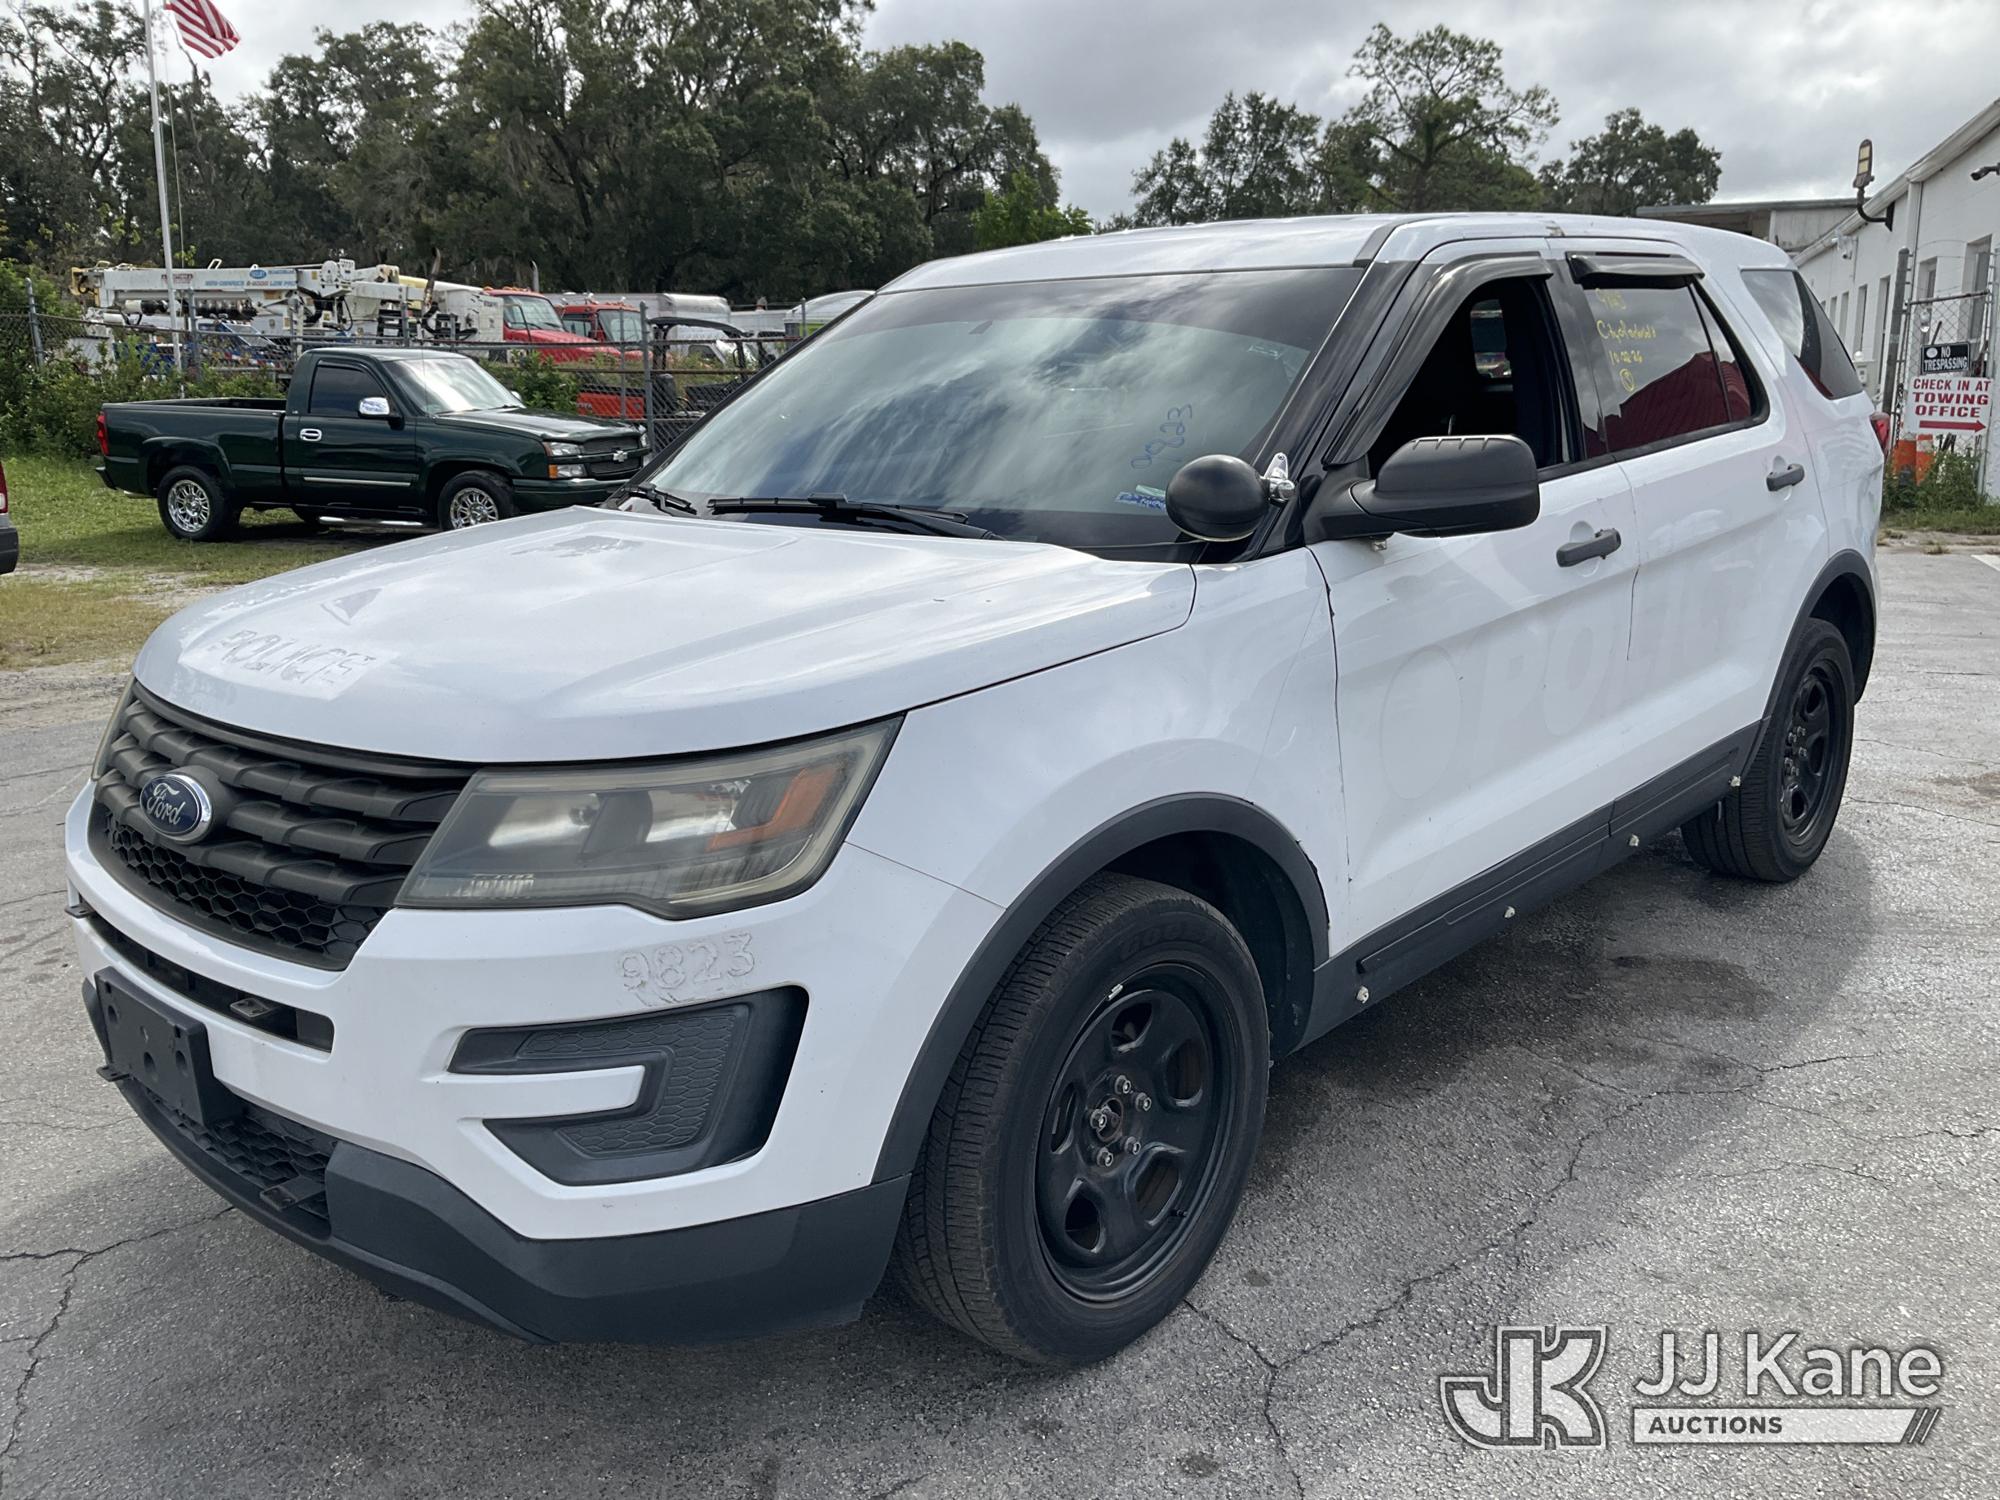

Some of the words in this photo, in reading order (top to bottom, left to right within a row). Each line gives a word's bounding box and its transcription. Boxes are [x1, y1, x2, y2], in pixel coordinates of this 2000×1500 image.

[1941, 346, 1951, 358] NO
[1924, 356, 1968, 371] TRESPASSING
[1913, 378, 1951, 390] CHECK
[1957, 380, 1970, 391] IN
[1975, 380, 1991, 391] AT
[1912, 391, 1989, 405] TOWING
[1915, 404, 1981, 418] OFFICE
[146, 782, 186, 825] Ford
[622, 932, 755, 992] 9823
